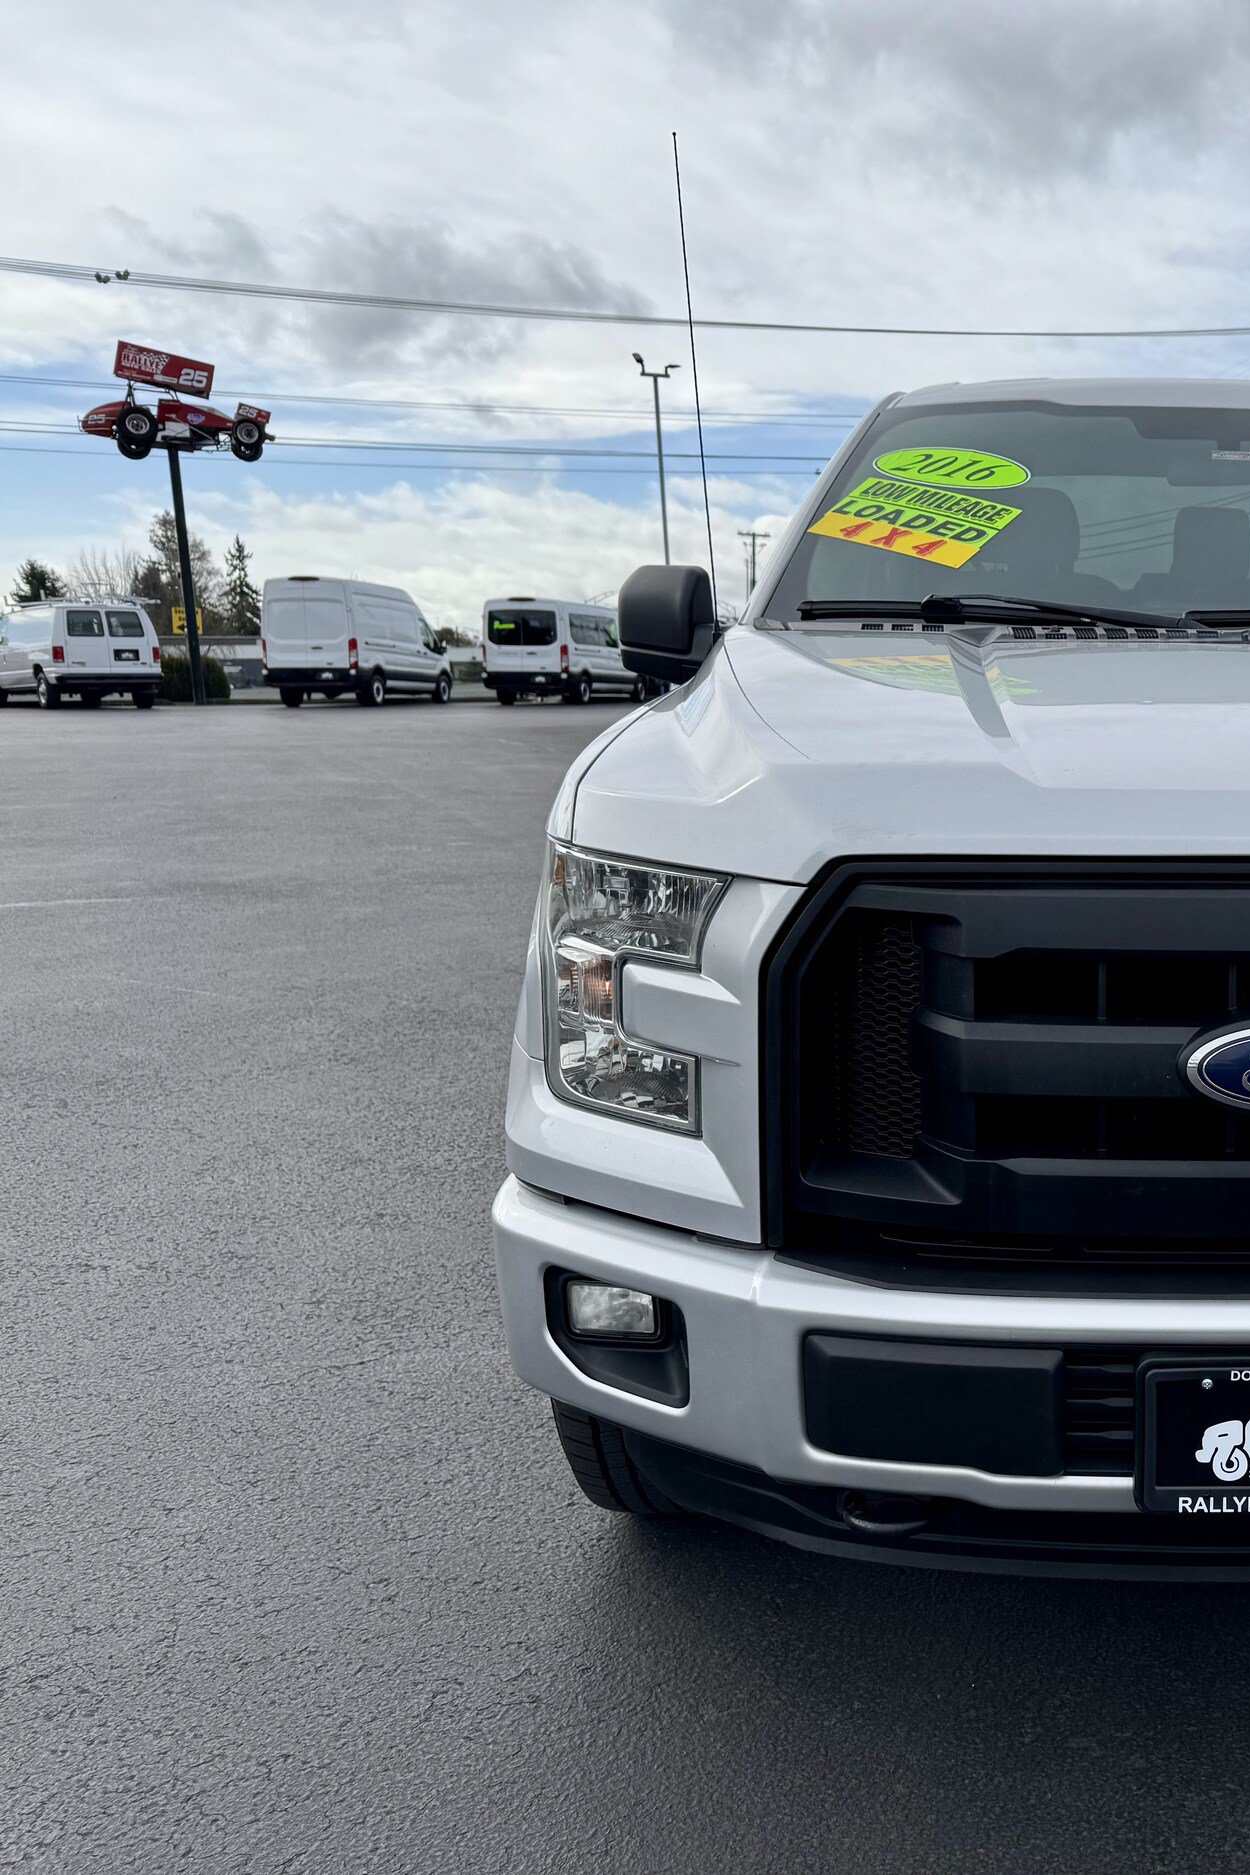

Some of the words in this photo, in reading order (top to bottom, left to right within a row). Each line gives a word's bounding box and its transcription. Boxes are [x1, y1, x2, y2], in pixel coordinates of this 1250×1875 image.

[178, 368, 208, 388] 25
[87, 413, 106, 424] 25
[239, 405, 258, 418] 25
[892, 453, 1012, 482] 2016
[858, 480, 908, 500] LOW
[905, 488, 1011, 524] MILEAGE
[832, 499, 988, 543] LOADED
[839, 521, 873, 538] 4
[870, 526, 913, 548] X
[911, 539, 948, 557] 4
